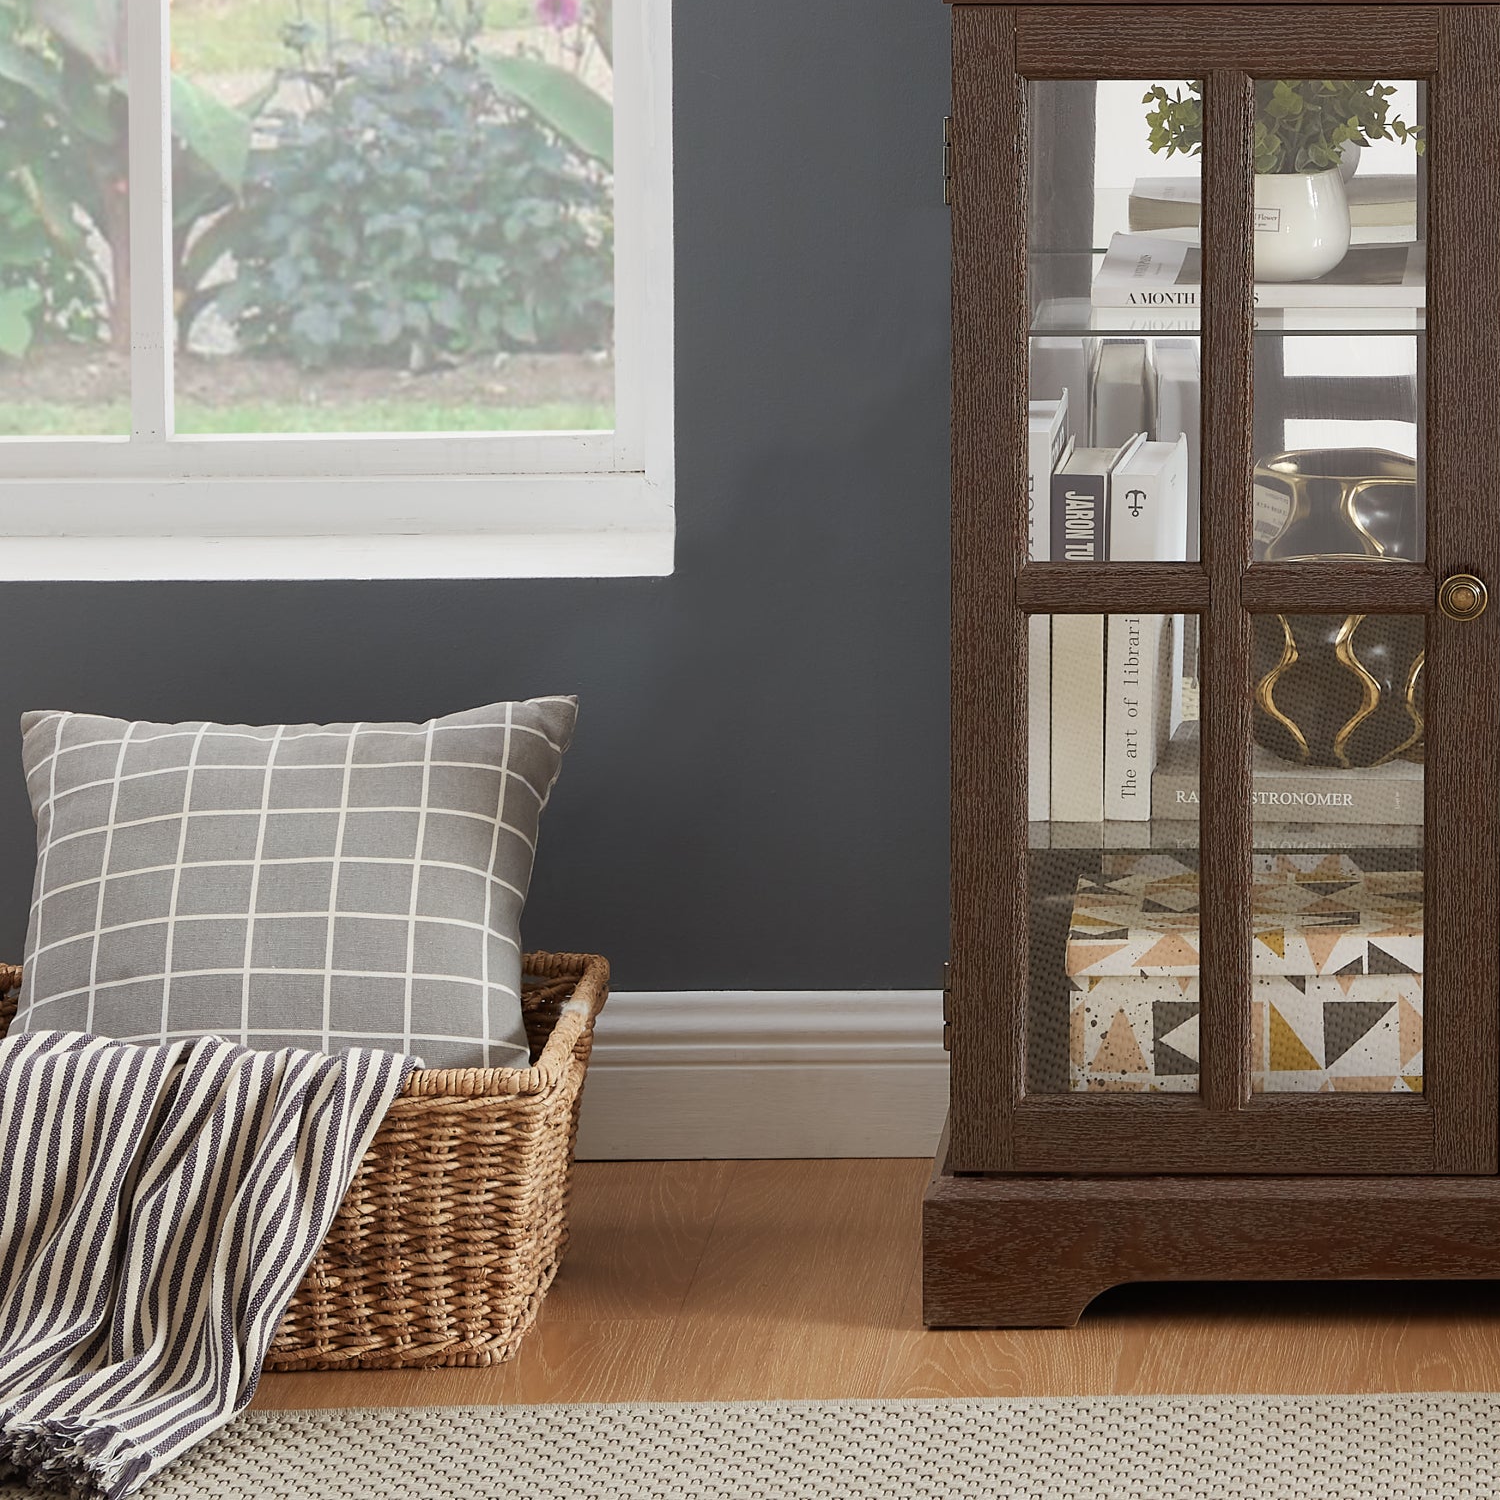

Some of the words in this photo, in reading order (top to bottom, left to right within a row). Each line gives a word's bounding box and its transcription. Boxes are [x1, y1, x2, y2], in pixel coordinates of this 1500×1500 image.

[1125, 292, 1137, 305] A
[1139, 292, 1195, 305] MONTH
[1064, 491, 1095, 540] JARON
[1123, 697, 1139, 718] of
[1124, 728, 1137, 759] art
[1121, 769, 1137, 799] The
